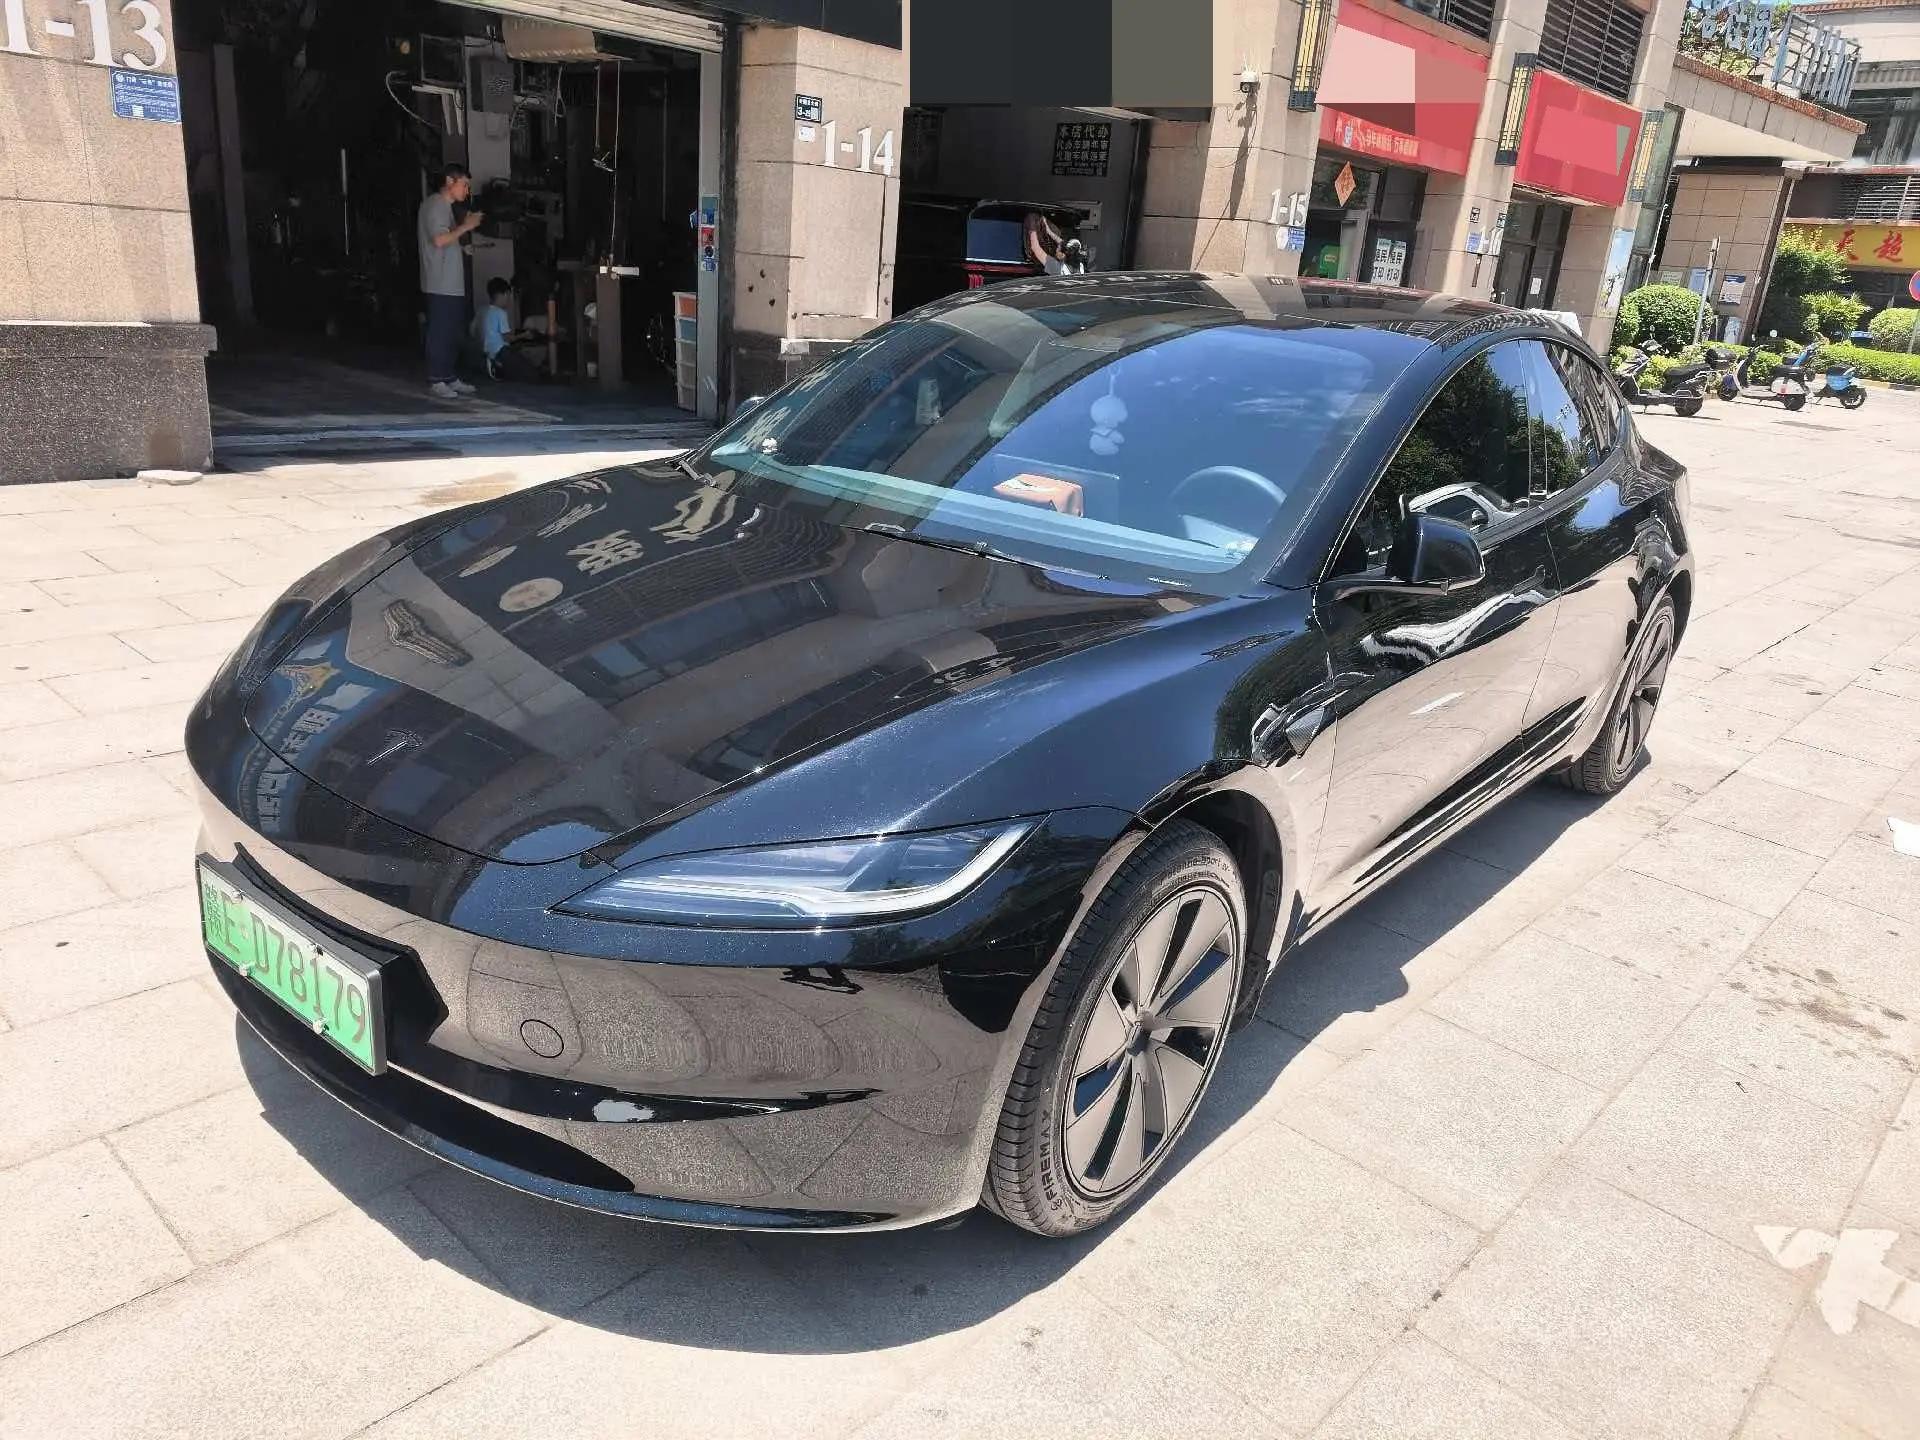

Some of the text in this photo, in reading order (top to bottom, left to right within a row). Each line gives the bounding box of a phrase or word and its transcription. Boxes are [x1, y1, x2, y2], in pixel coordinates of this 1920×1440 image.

[0, 0, 167, 70] 1-13
[821, 120, 894, 176] 1-14
[1268, 188, 1310, 227] 1-15
